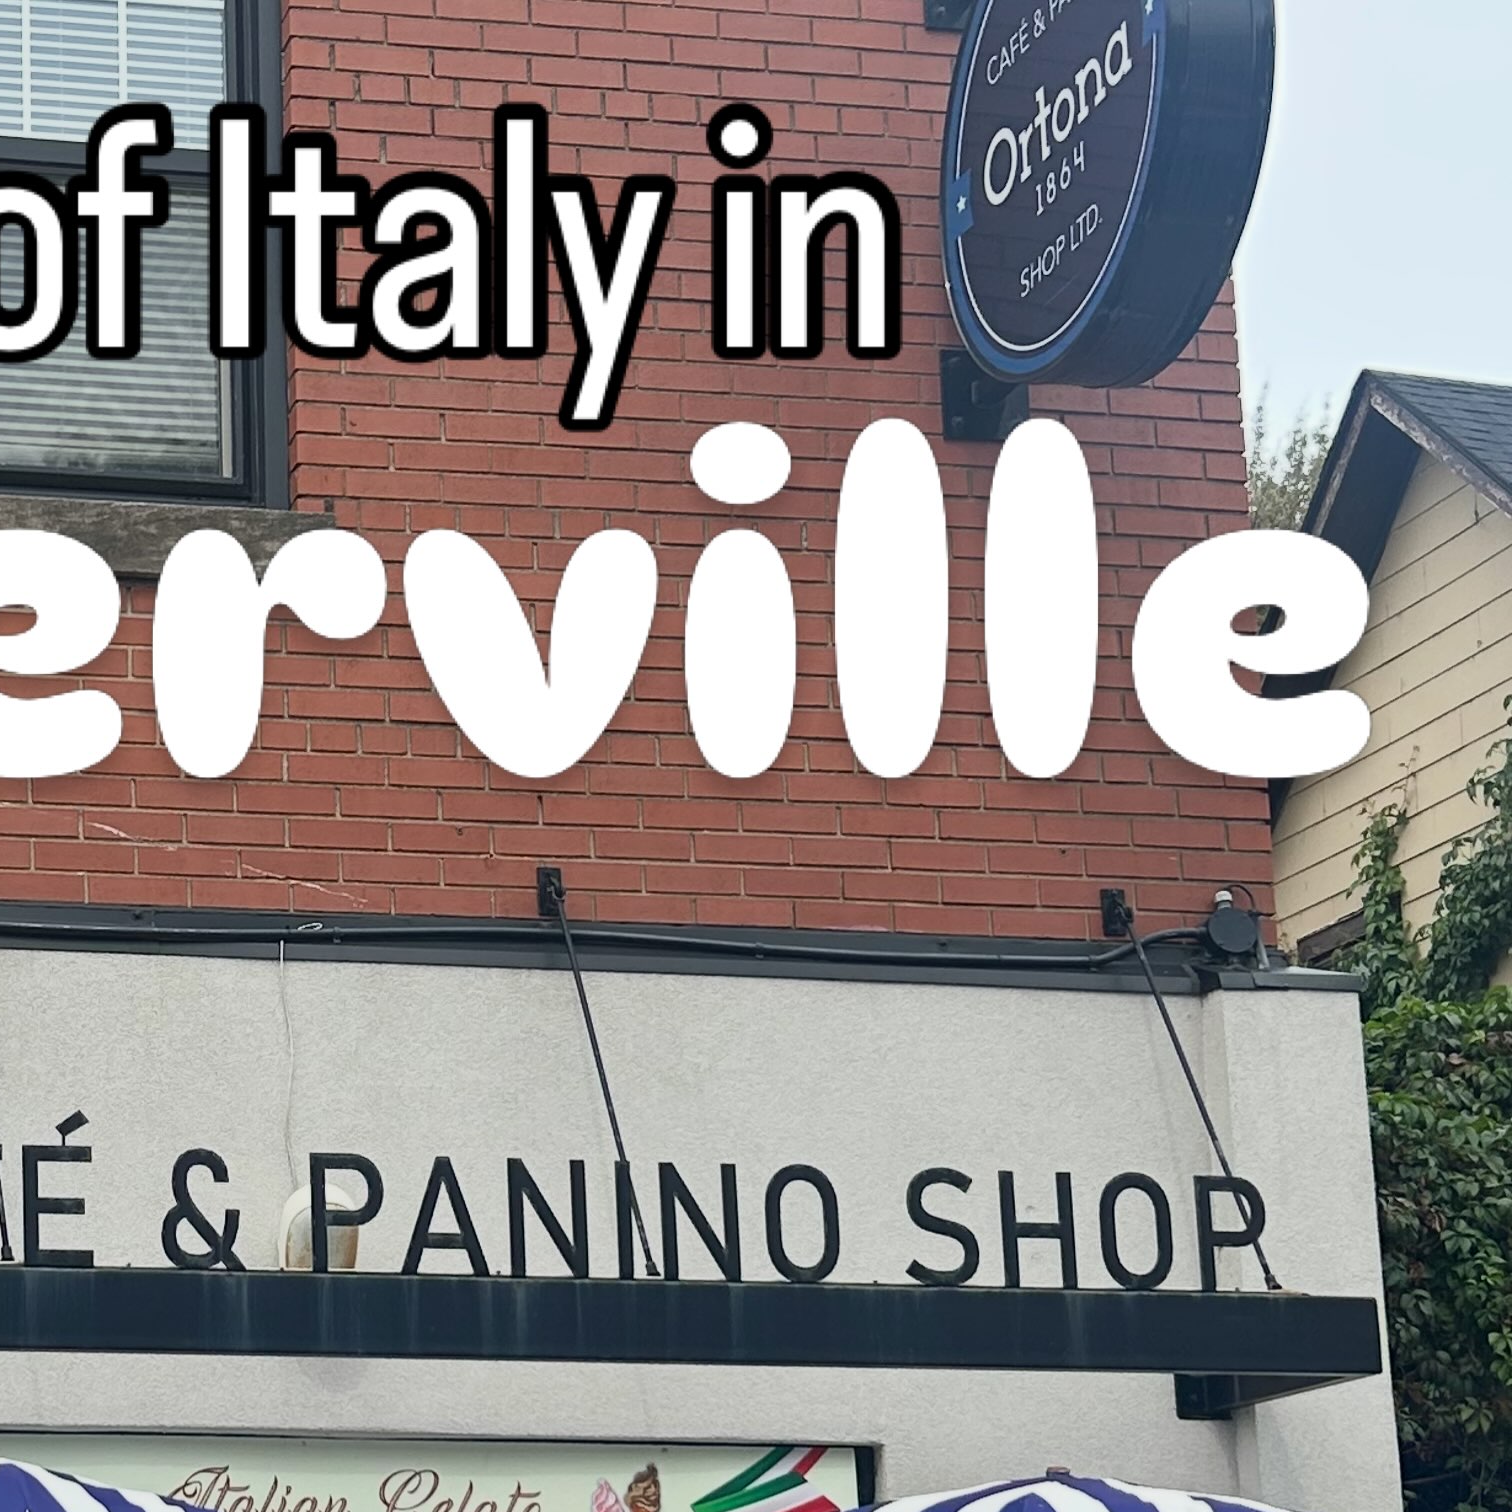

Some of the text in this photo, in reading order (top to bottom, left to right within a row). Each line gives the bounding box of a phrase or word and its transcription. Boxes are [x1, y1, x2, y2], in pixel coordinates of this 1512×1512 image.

[987, 17, 1030, 85] CAFÉ
[1033, 8, 1047, 38] &
[984, 20, 1133, 206] Ortona
[1035, 140, 1085, 216] 1864
[1021, 203, 1104, 298] SHOP LTD.
[161, 1148, 247, 1272] &
[310, 1153, 840, 1283] PANINO
[905, 1166, 1266, 1293] SHOP
